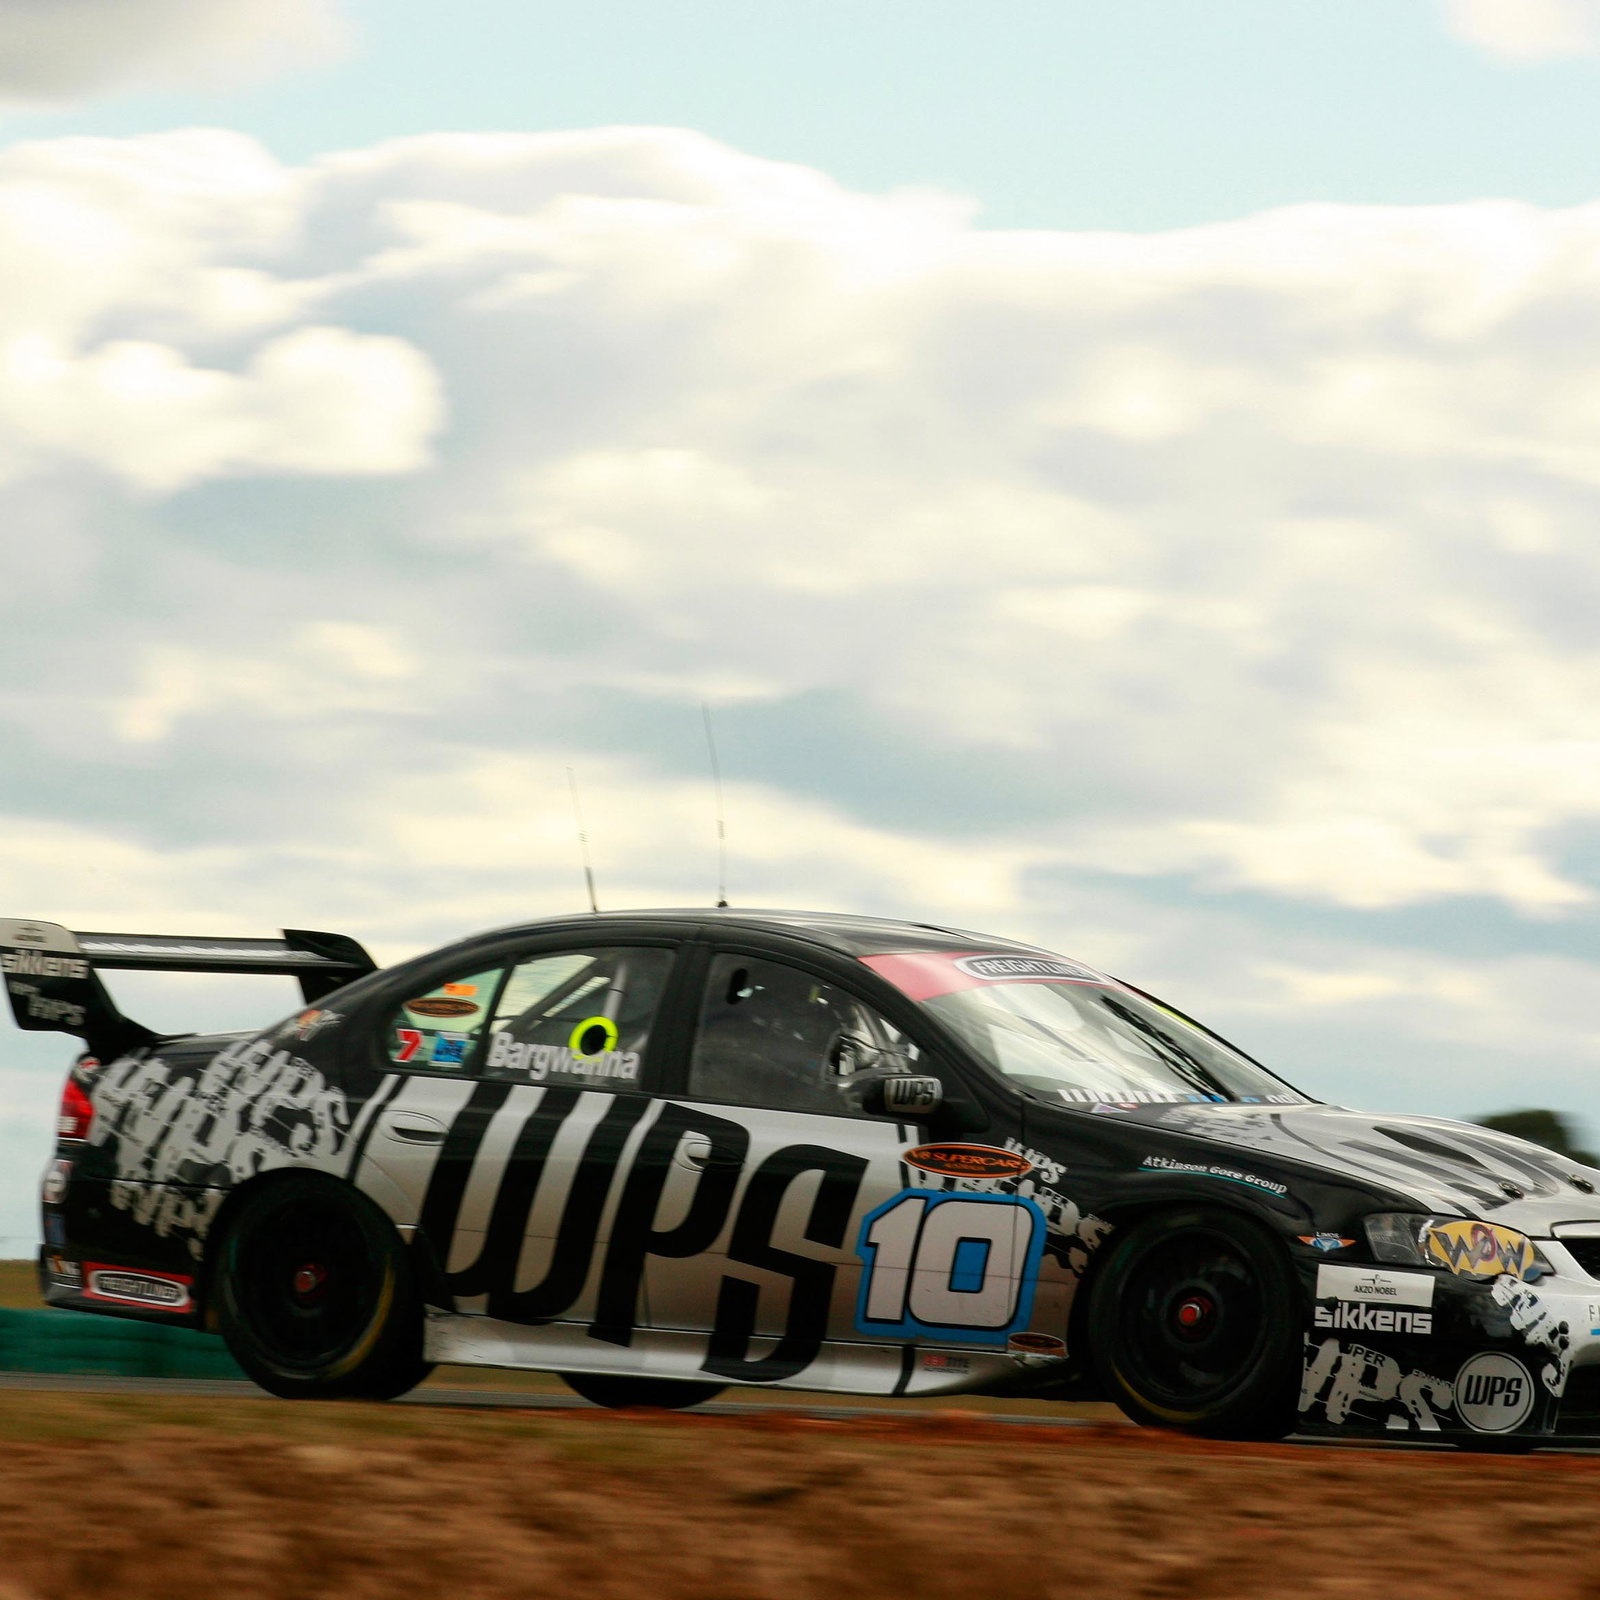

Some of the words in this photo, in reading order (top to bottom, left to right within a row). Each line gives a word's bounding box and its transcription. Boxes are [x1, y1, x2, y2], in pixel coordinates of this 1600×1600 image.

[894, 1080, 935, 1105] WPS
[1142, 1155, 1207, 1173] Atkinson
[1209, 1165, 1243, 1180] Gore
[1244, 1174, 1288, 1195] Group
[421, 1081, 869, 1382] WPS
[1433, 1222, 1527, 1276] WOW
[864, 1194, 1037, 1331] 10
[1353, 1284, 1374, 1295] AKZO
[1374, 1286, 1397, 1296] NOBEL
[1314, 1301, 1433, 1335] sikkens
[1463, 1375, 1523, 1408] WPS
